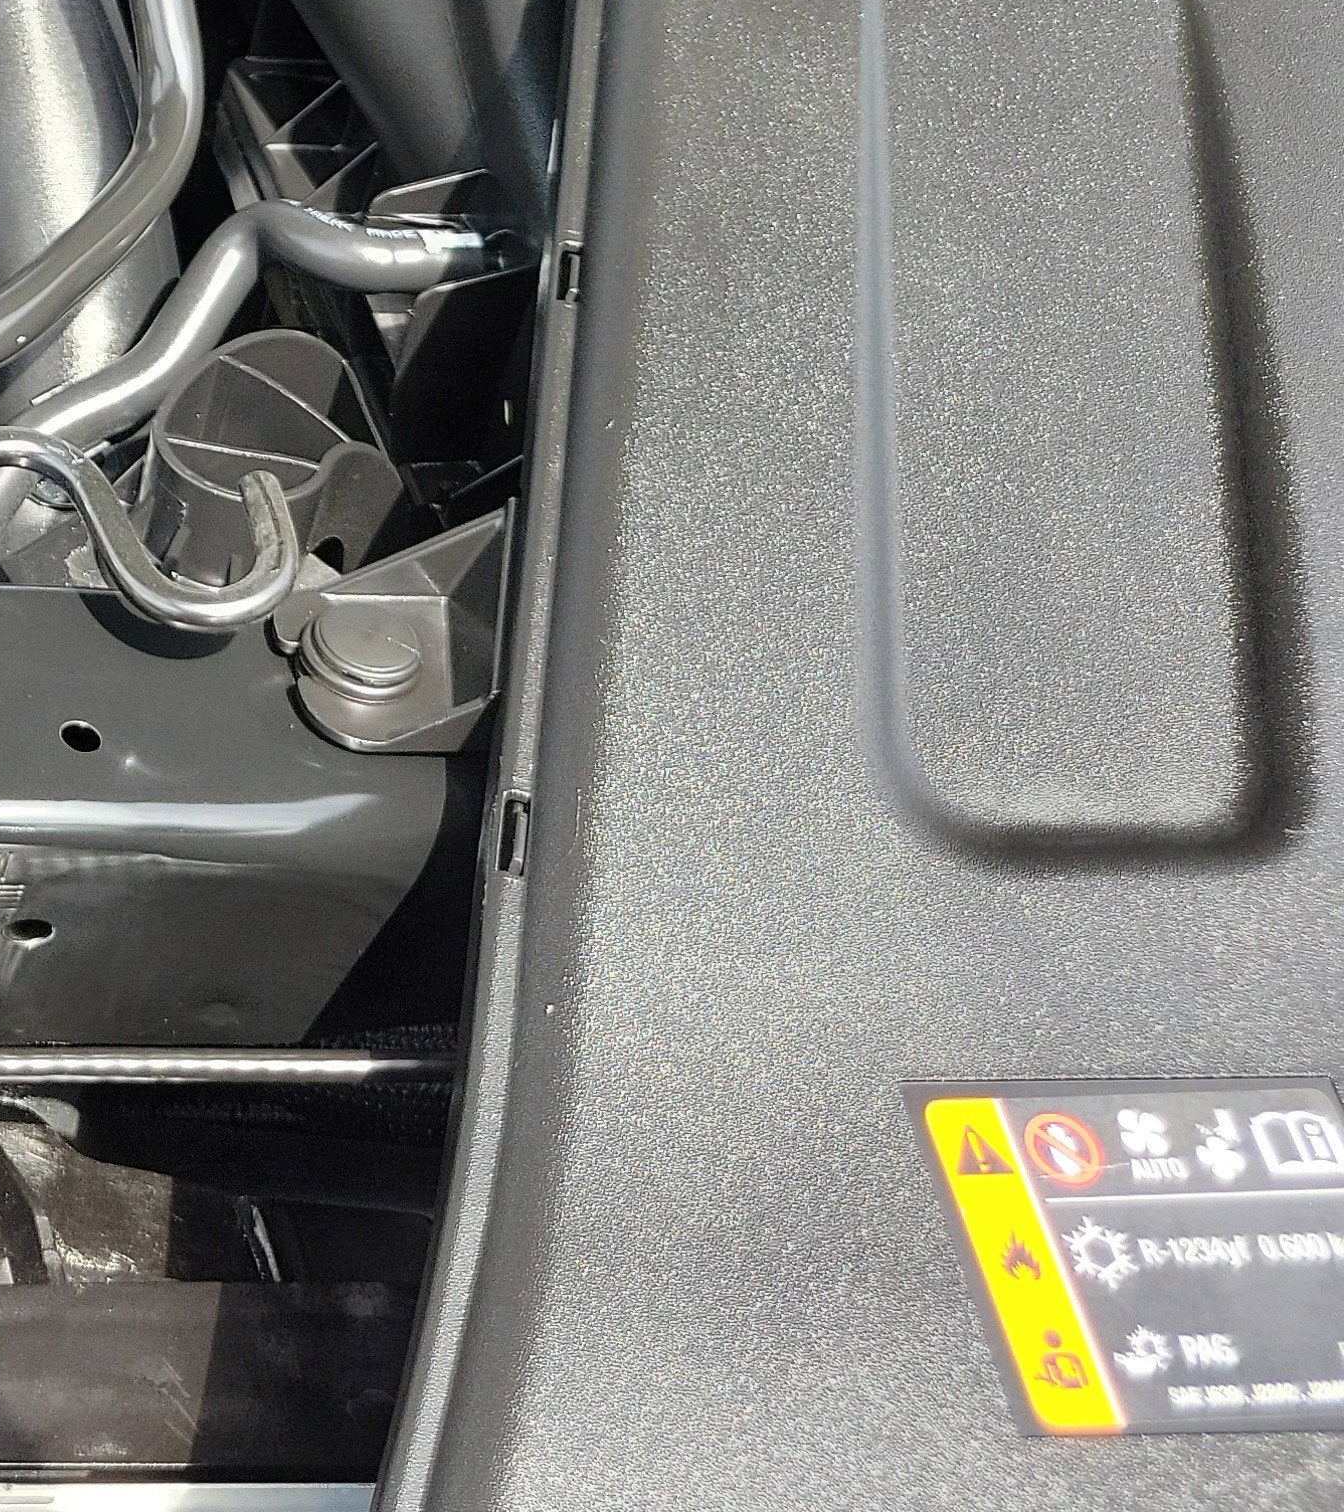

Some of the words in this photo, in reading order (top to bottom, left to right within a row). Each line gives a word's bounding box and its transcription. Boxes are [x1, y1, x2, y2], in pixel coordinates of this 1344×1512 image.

[1130, 1158, 1188, 1180] AUTO
[1138, 1234, 1251, 1267] R-1234yf
[1258, 1233, 1329, 1259] 0.600
[1179, 1334, 1238, 1364] PAG
